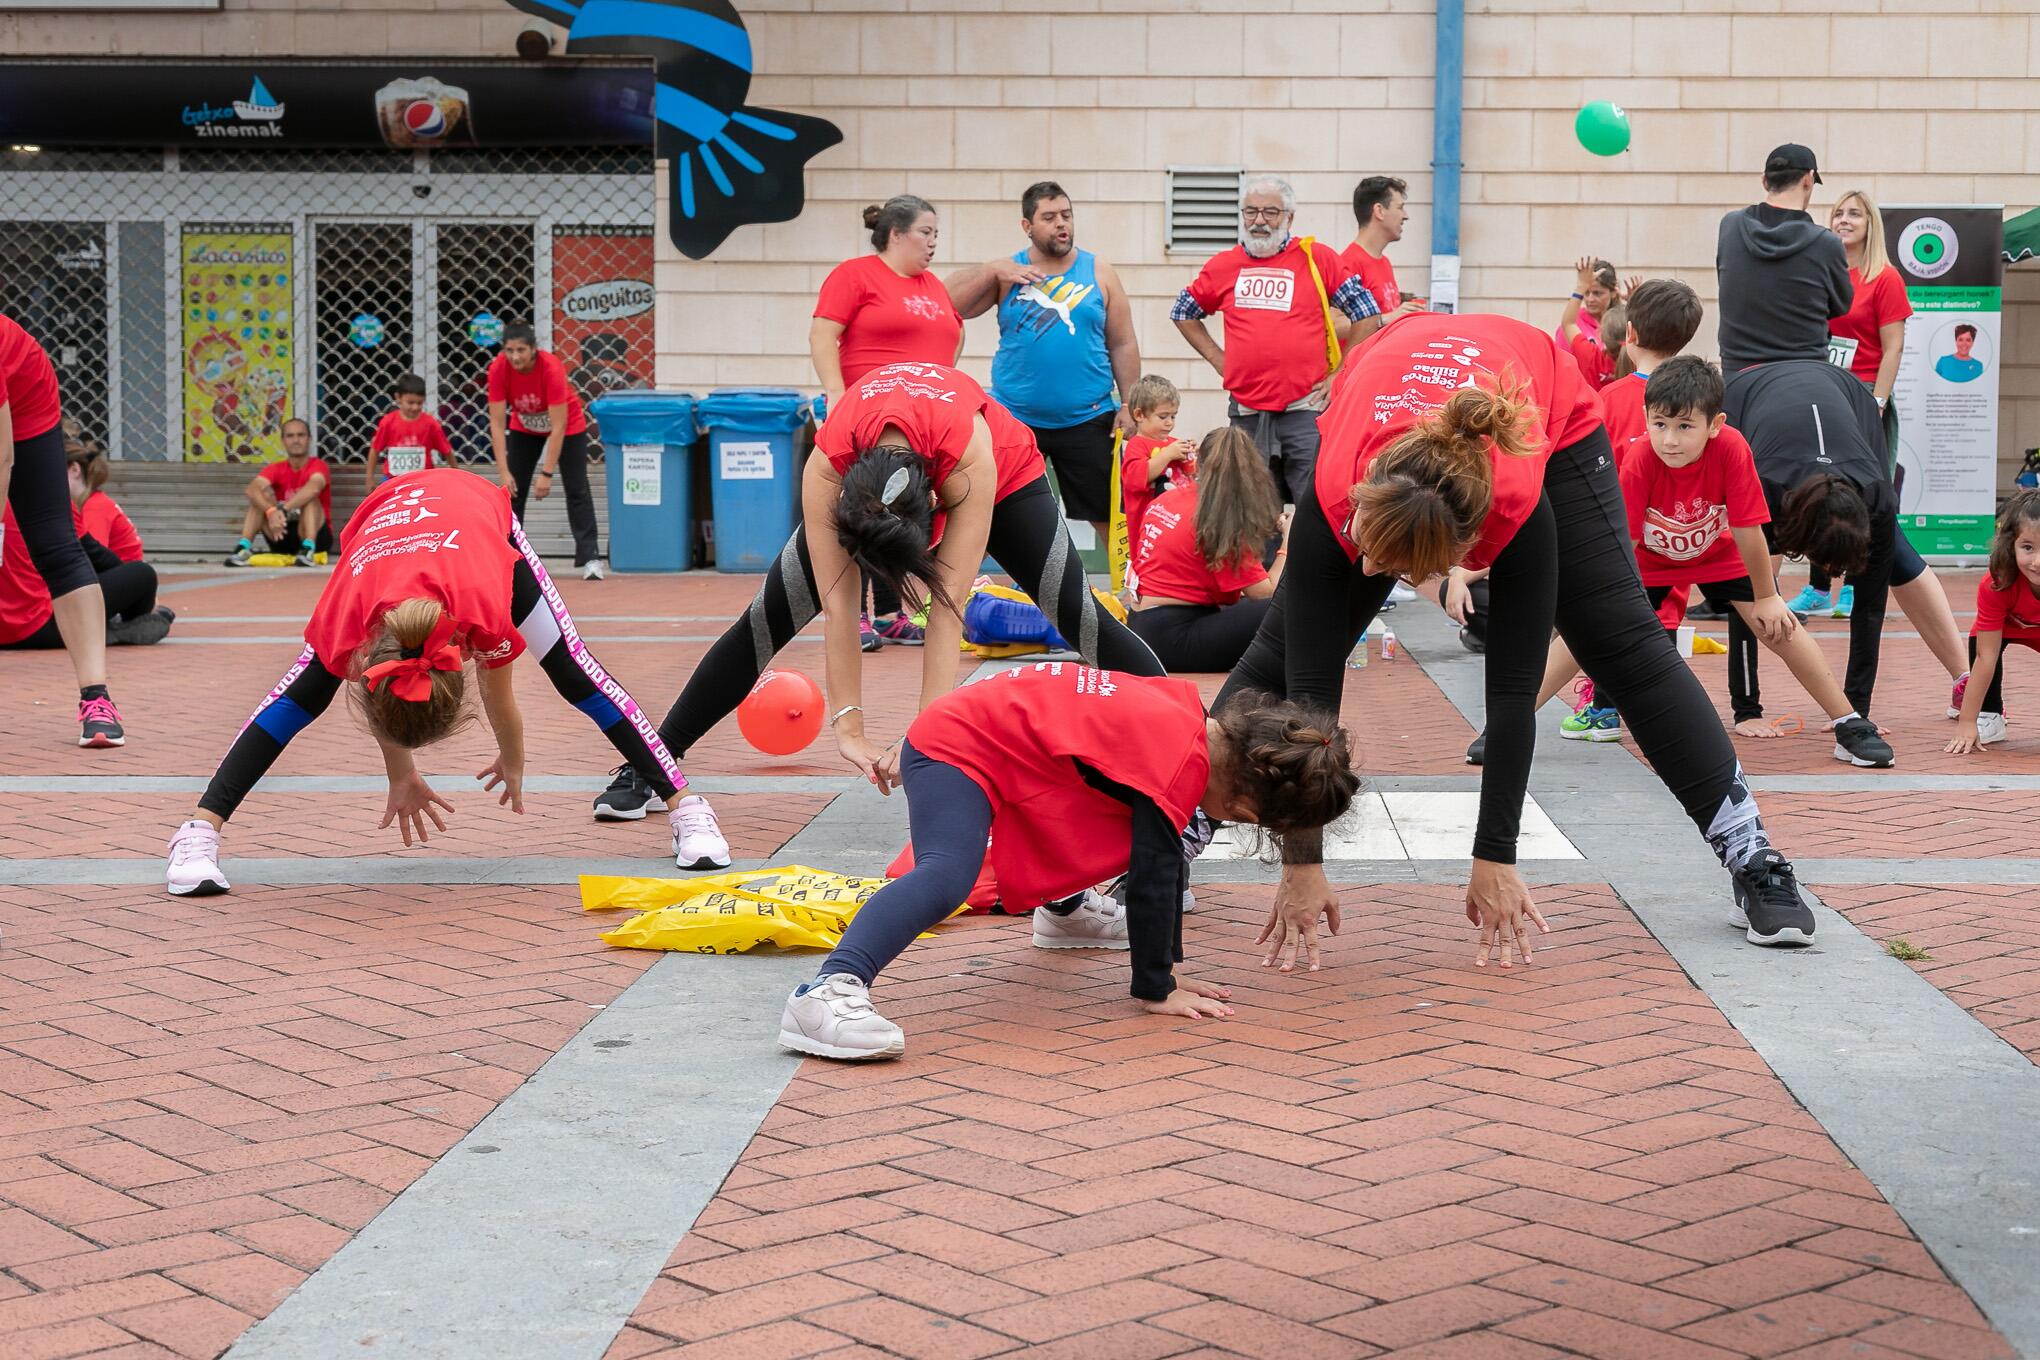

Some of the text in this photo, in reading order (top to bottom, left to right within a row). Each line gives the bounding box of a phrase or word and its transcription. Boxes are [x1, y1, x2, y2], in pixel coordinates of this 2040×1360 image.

[194, 121, 284, 137] zinemak
[1916, 223, 1943, 232] TENGO
[1241, 278, 1287, 299] 3009
[567, 287, 653, 314] conguitos
[1829, 348, 1848, 367] 01
[1413, 364, 1460, 378] Bilbao
[1401, 372, 1457, 389] Seguros
[392, 456, 422, 470] 2039
[373, 509, 411, 523] Bilbao
[364, 516, 411, 535] Seguros
[1651, 517, 1721, 552] 3004
[520, 542, 540, 576] GRL
[559, 616, 581, 652] GRL
[602, 679, 632, 712] GRL
[655, 743, 679, 779] GRL
